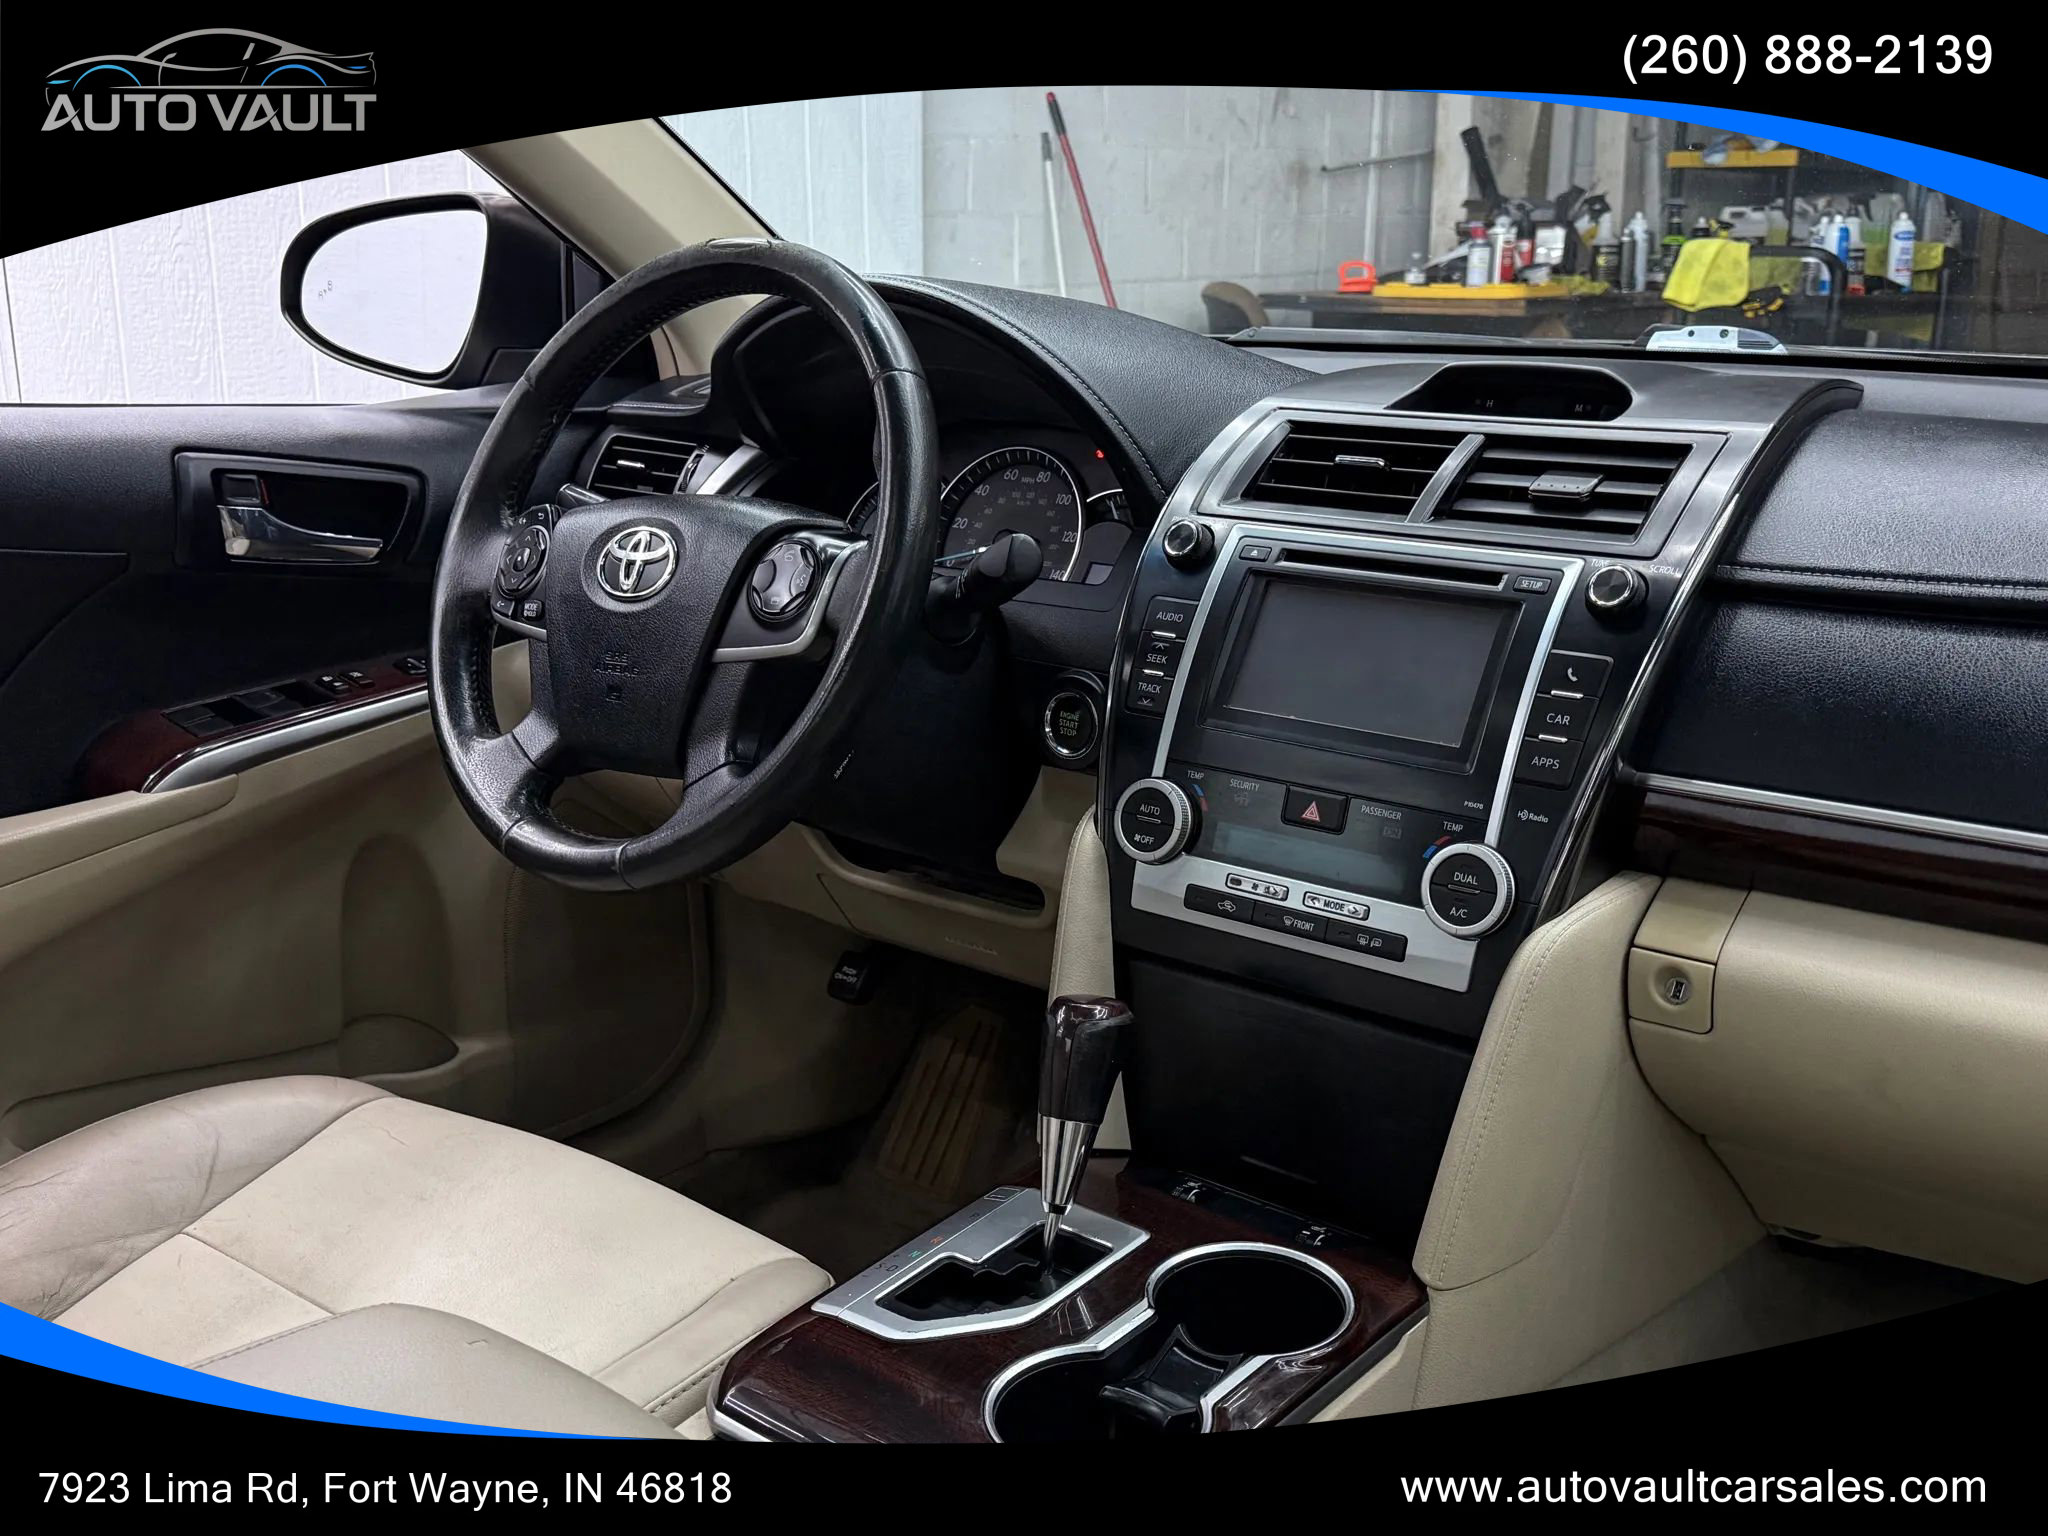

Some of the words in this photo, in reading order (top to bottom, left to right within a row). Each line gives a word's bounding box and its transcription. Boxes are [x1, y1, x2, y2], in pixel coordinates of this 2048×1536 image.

[1003, 468, 1019, 481] 60
[1036, 471, 1051, 483] 80
[974, 485, 990, 497] 40
[1055, 493, 1072, 505] 100
[952, 517, 968, 529] 20
[1061, 531, 1077, 543] 120
[1649, 564, 1681, 575] SCROLL
[1520, 580, 1543, 589] SETUP
[1156, 611, 1184, 623] AUDIO
[1146, 653, 1168, 664] SEEK
[1137, 682, 1162, 694] TRACK
[1059, 719, 1079, 729] START
[1546, 713, 1571, 725] CAR
[1060, 727, 1077, 736] STOP
[1531, 756, 1560, 769] APPS
[1187, 770, 1205, 780] TEMP
[1229, 778, 1260, 792] SECURITY
[1139, 804, 1161, 816] AUTO
[1360, 804, 1402, 821] PASSENGER
[1528, 812, 1549, 823] Radio
[1443, 820, 1464, 832] TEMP
[1140, 834, 1155, 845] OFF
[1453, 871, 1478, 886] DUAL
[1323, 898, 1346, 912] MODE
[1449, 906, 1468, 919] A/C
[1293, 918, 1316, 932] FRONT
